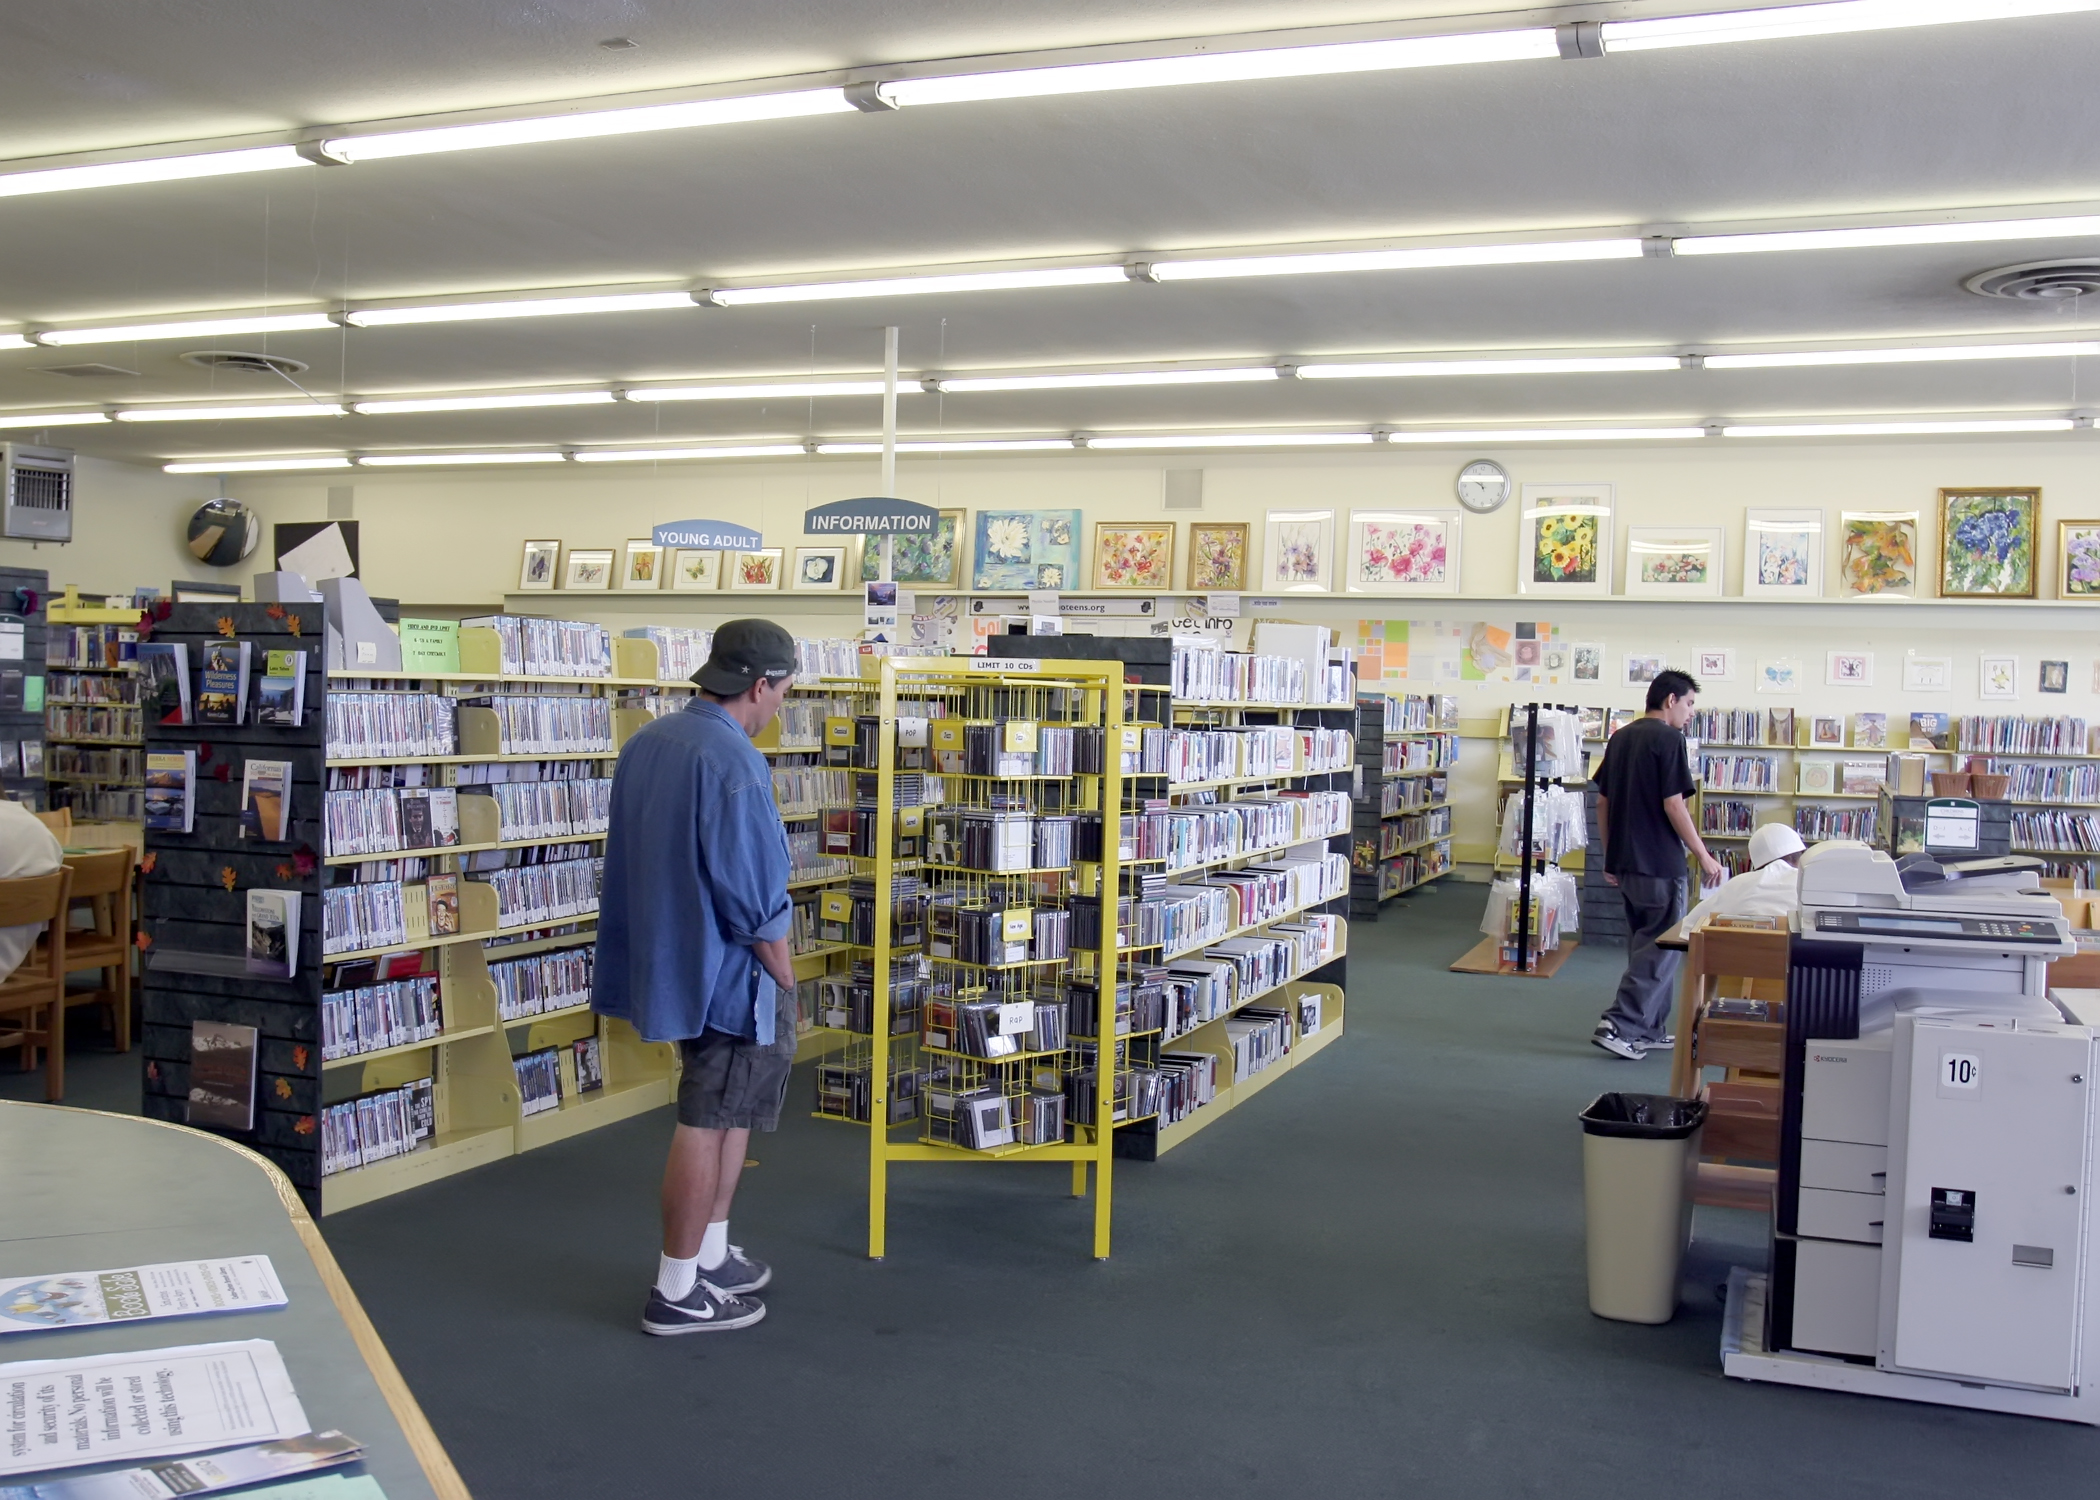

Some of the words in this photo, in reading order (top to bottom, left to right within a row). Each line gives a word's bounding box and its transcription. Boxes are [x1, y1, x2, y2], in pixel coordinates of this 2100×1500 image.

[811, 514, 932, 531] INFORMATION
[658, 531, 710, 546] YOUNG
[713, 534, 759, 549] ADULT
[977, 661, 1001, 670] LIMIT
[1004, 661, 1015, 670] 10
[1017, 662, 1034, 671] CDs
[205, 670, 237, 681] Wilderness
[205, 679, 235, 689] Pleasures
[1919, 718, 1938, 728] BIG
[1948, 1058, 1977, 1083] 10¢
[420, 1096, 432, 1107] SPY
[420, 1118, 433, 1128] COLD
[102, 1272, 140, 1292] Sale
[108, 1291, 149, 1318] Book
[95, 1376, 113, 1385] be
[123, 1375, 144, 1394] stored
[152, 1368, 176, 1403] technology.
[37, 1384, 55, 1395] its
[65, 1374, 91, 1403] personal
[95, 1384, 114, 1398] will
[6, 1382, 27, 1420] circulation
[36, 1394, 55, 1403] of
[131, 1394, 146, 1403] or
[67, 1403, 87, 1416] No
[158, 1403, 179, 1418] this
[37, 1404, 61, 1432] security
[98, 1397, 121, 1441] information
[128, 1404, 151, 1435] collected
[6, 1421, 26, 1433] for
[162, 1416, 185, 1437] using
[12, 1432, 32, 1457] system
[38, 1432, 58, 1445] and
